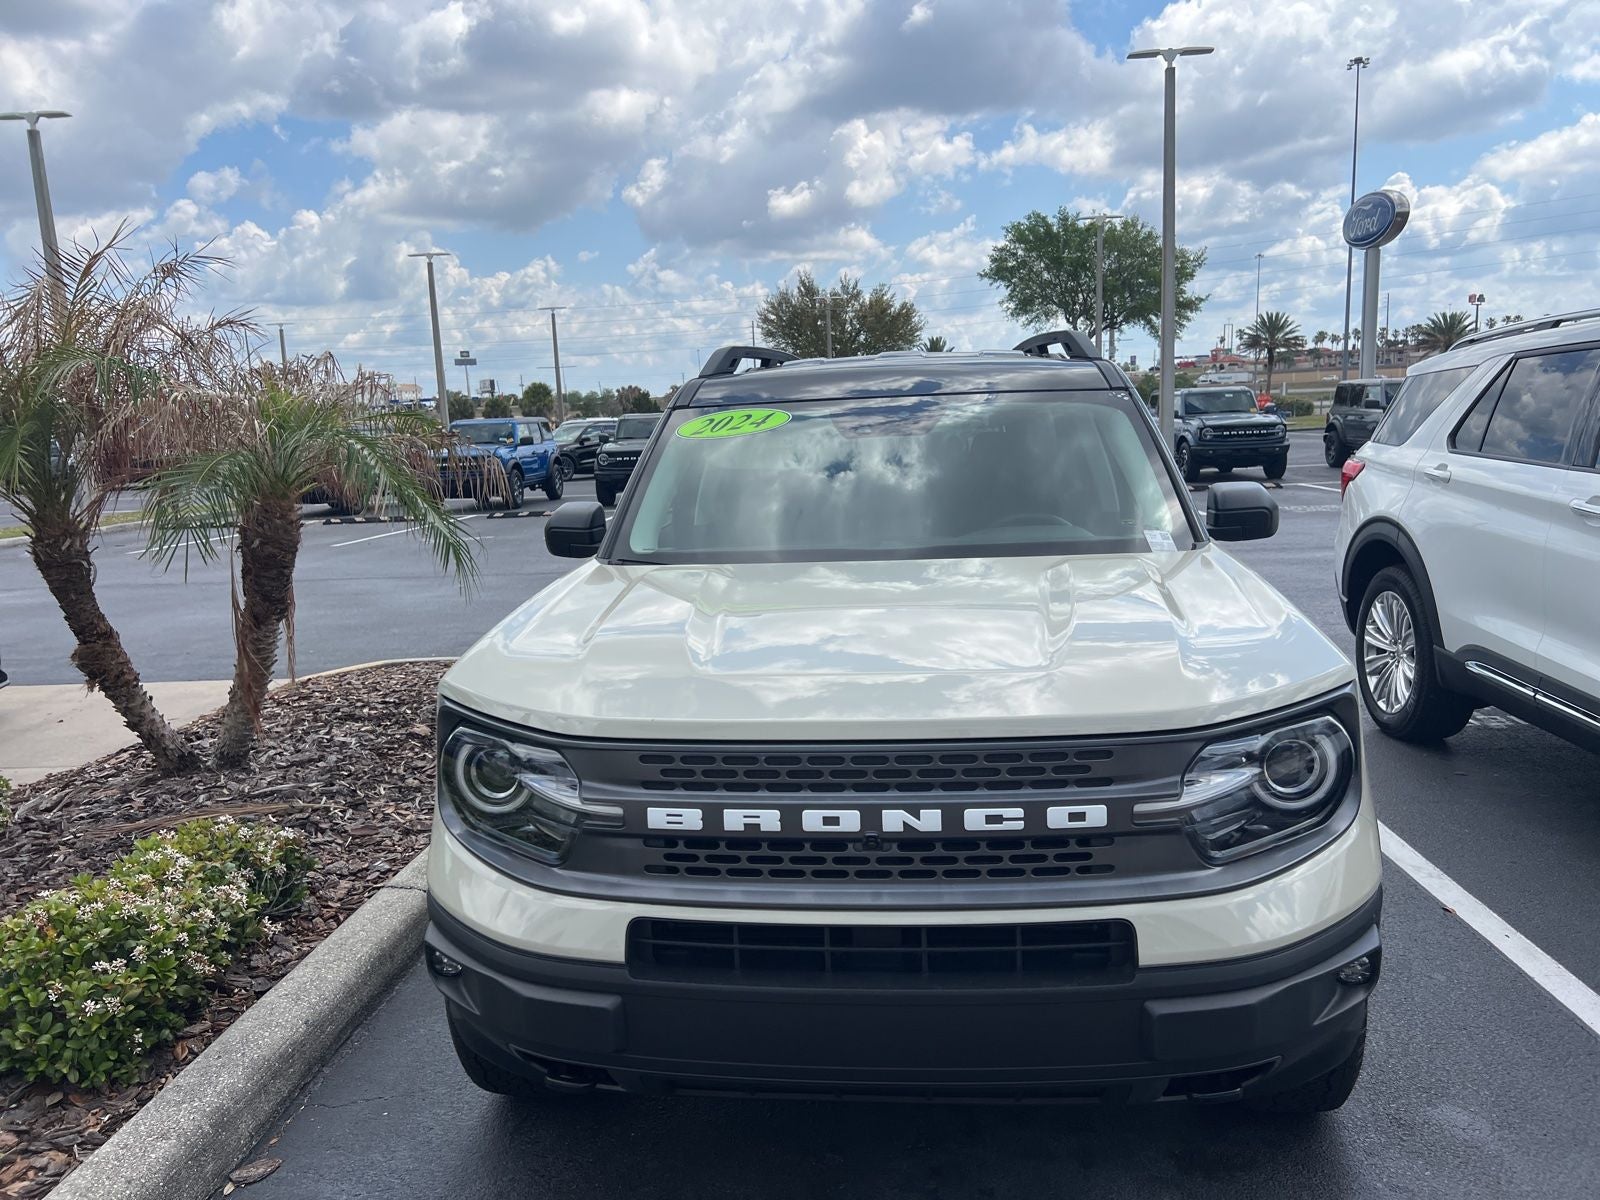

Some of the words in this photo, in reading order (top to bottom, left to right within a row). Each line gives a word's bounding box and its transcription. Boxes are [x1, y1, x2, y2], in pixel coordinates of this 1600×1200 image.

[1349, 203, 1380, 238] Ford
[690, 412, 775, 435] 2024
[646, 804, 1108, 832] BRONCO
